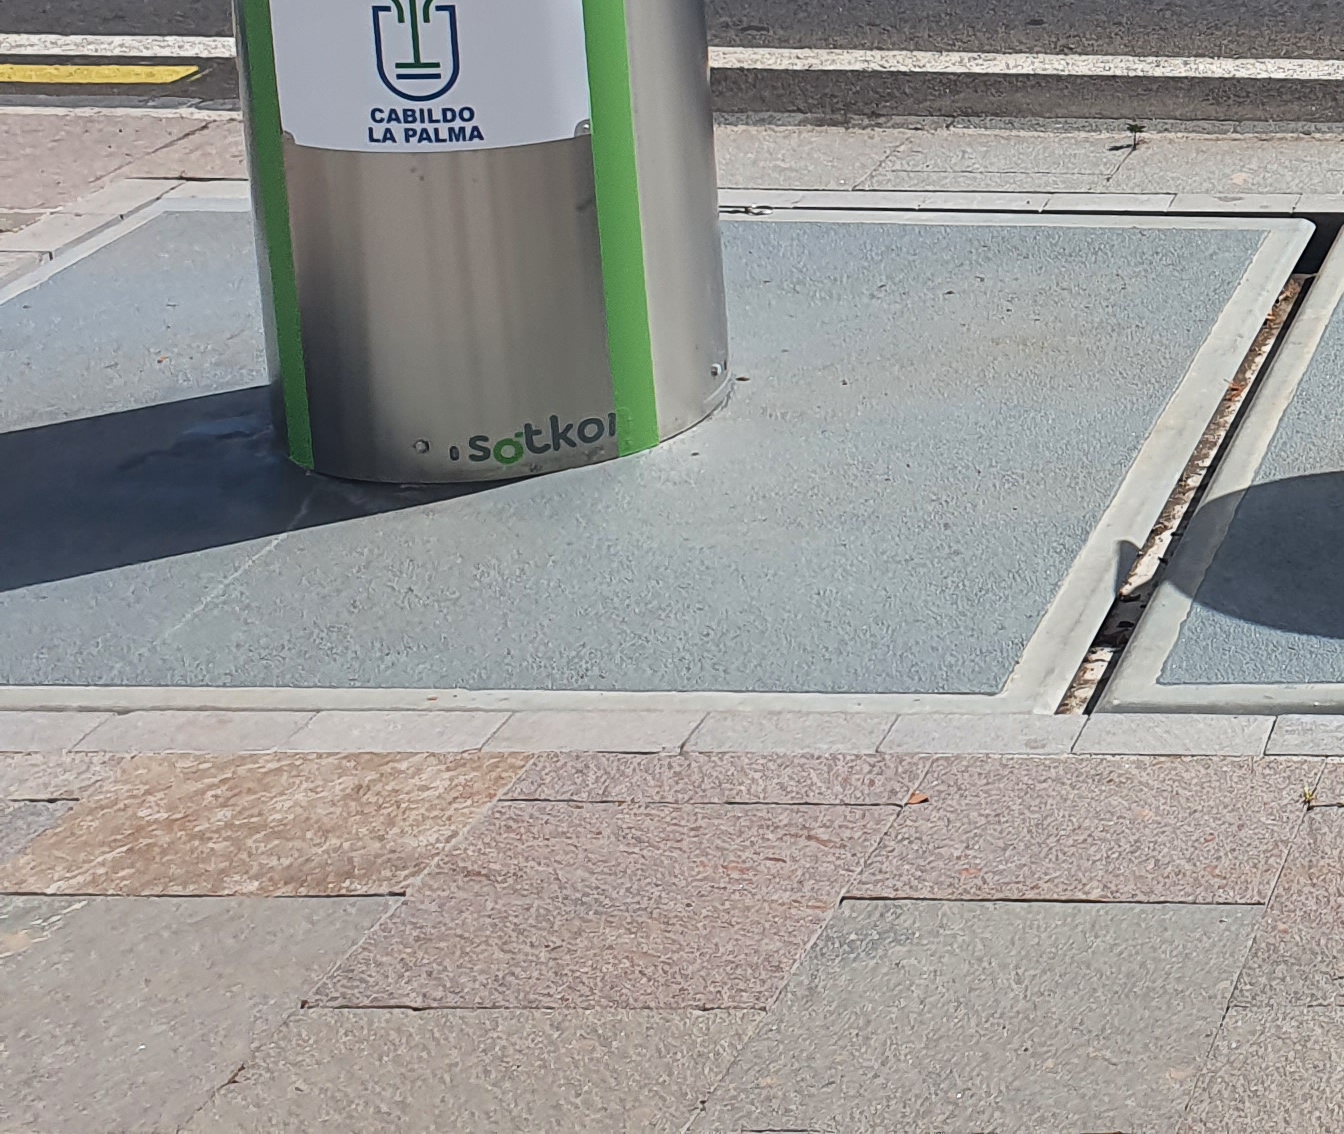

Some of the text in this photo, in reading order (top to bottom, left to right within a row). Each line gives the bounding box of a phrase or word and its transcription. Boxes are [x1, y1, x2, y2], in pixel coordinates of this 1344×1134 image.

[370, 106, 475, 124] CABILDO
[367, 125, 485, 144] LA PALMA
